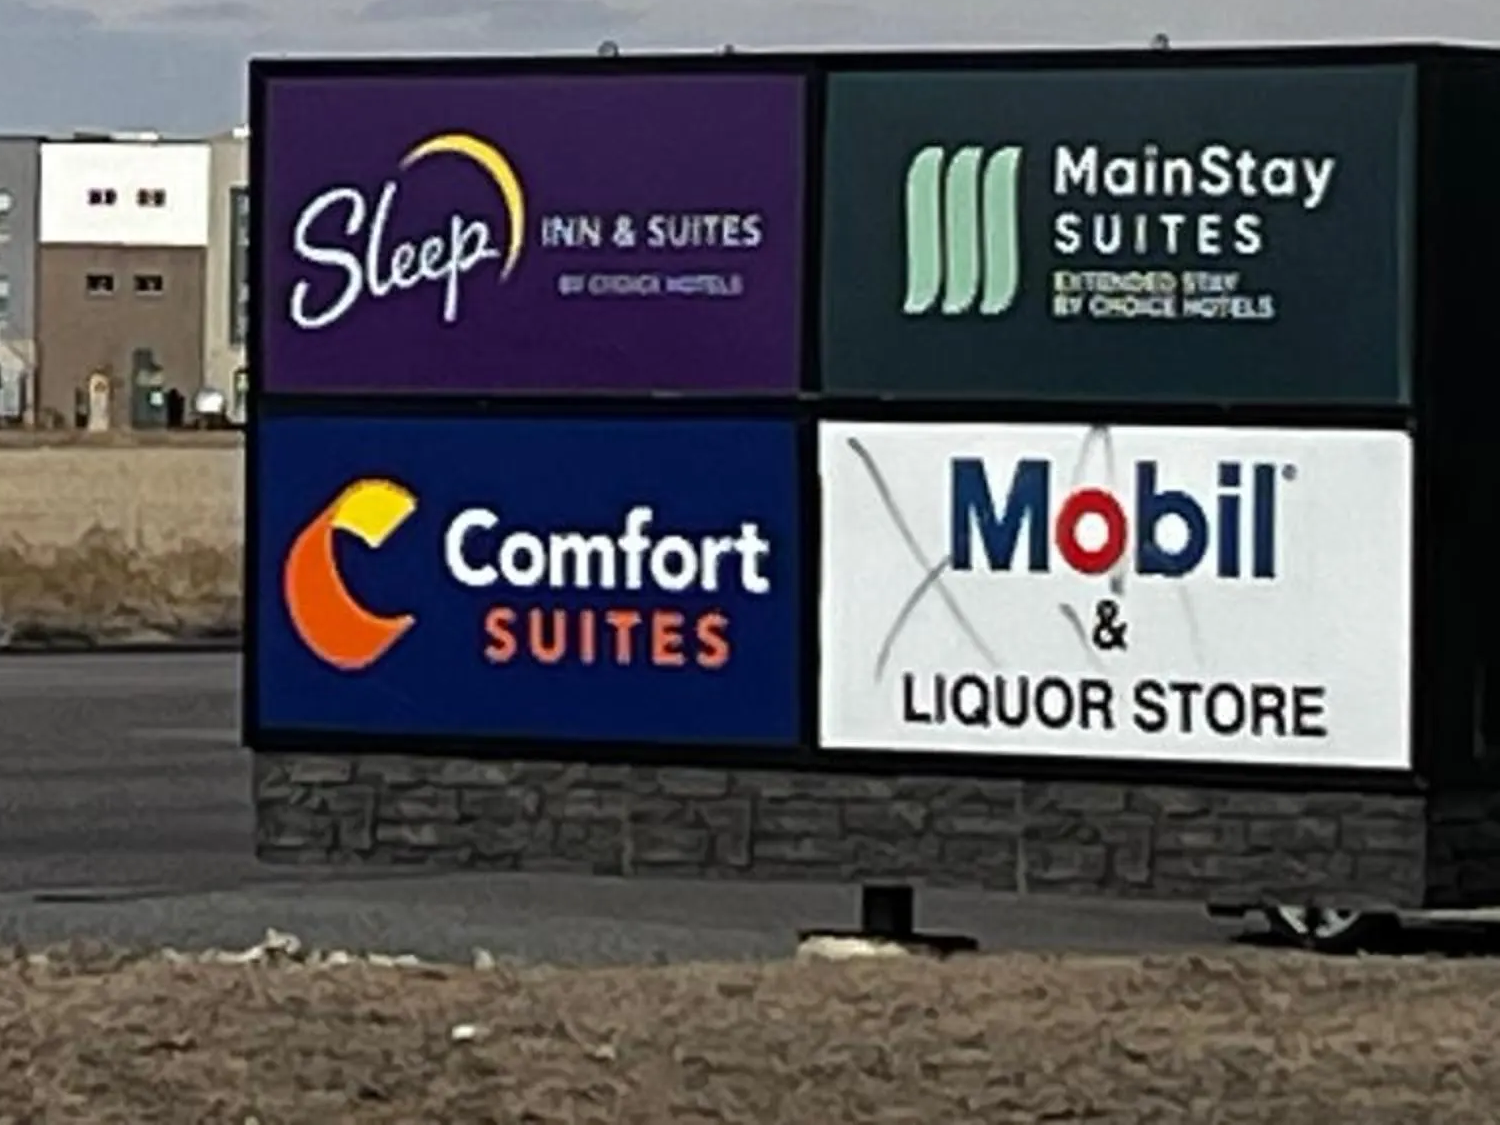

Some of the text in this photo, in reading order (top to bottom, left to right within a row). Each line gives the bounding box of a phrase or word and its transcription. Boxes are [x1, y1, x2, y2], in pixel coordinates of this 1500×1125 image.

[1053, 144, 1336, 209] MainStay
[290, 181, 501, 329] Sleep
[541, 215, 765, 248] INN & SUITES
[1053, 213, 1264, 255] SUITES
[445, 506, 771, 593] Comfort
[950, 457, 1277, 580] Mobil
[484, 606, 731, 668] SUITES
[1092, 600, 1128, 650] &
[902, 674, 1329, 737] LIQUOR STORE
